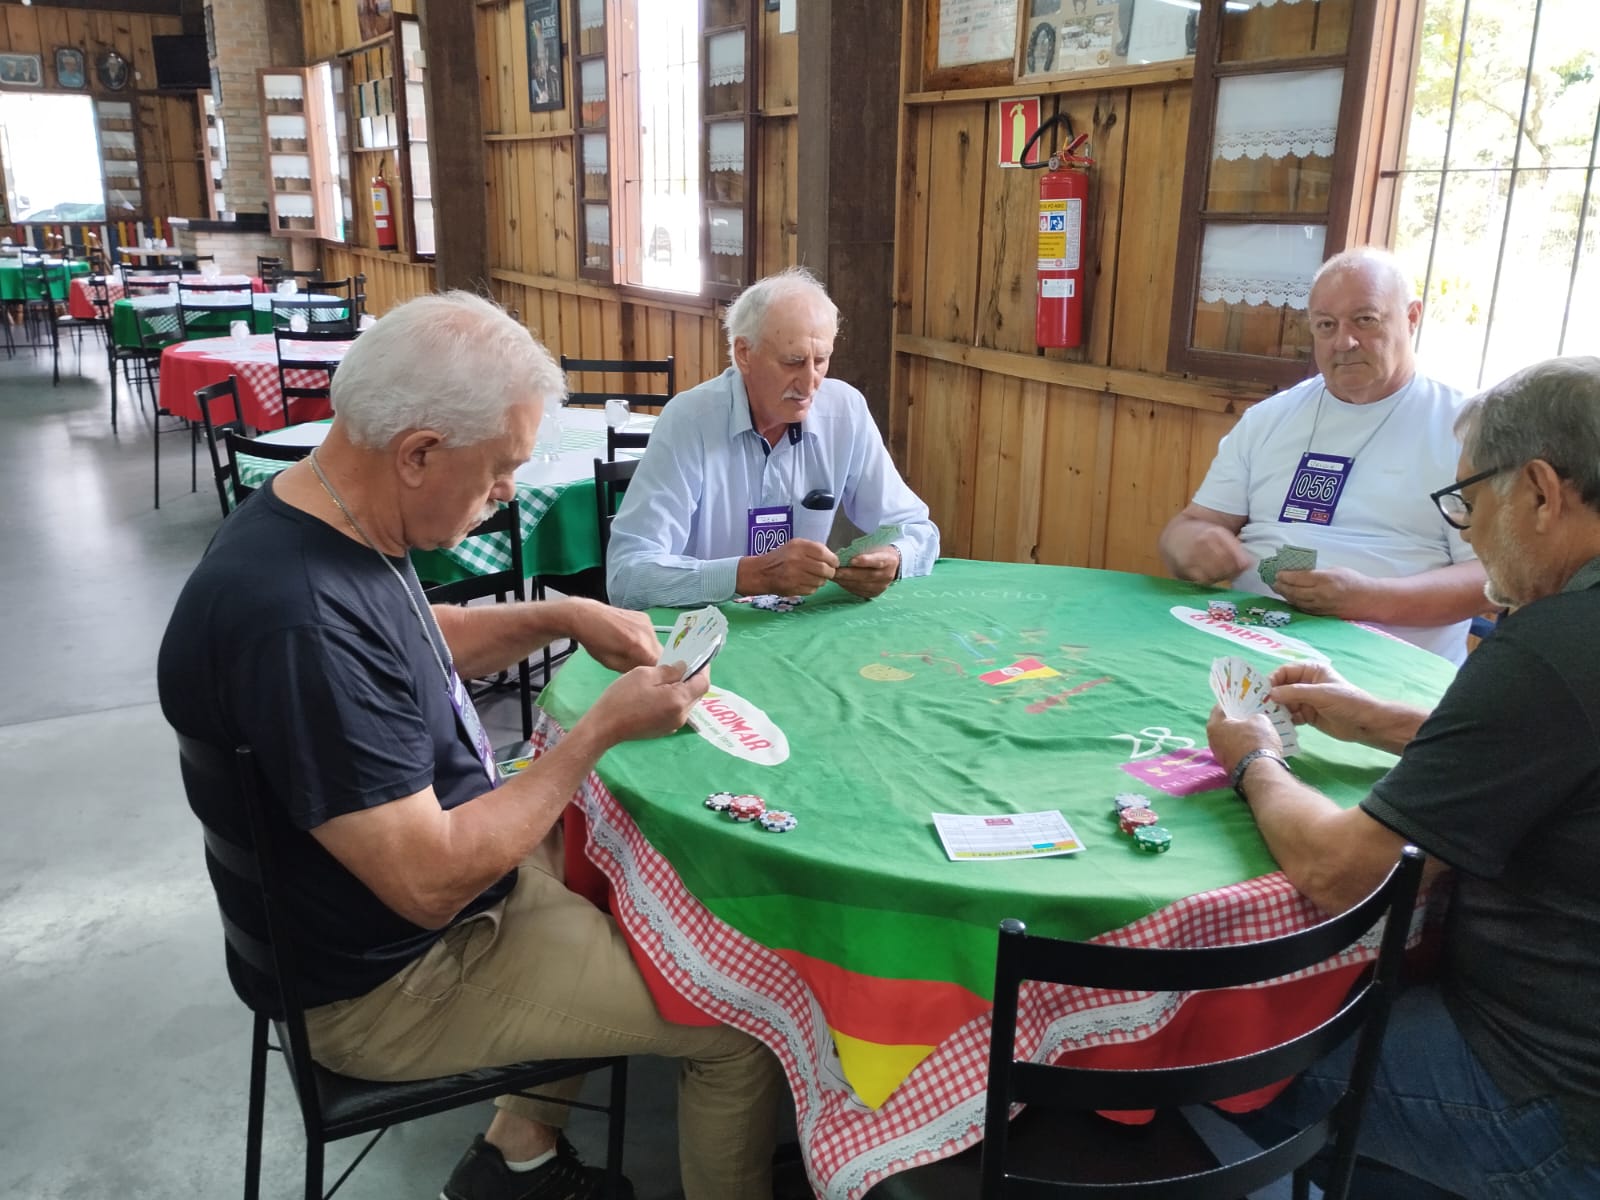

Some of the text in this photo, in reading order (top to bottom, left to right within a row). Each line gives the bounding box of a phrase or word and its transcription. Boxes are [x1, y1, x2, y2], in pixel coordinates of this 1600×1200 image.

[1296, 473, 1337, 501] 056
[754, 529, 788, 555] 029
[700, 699, 772, 751] AGRIMAR
